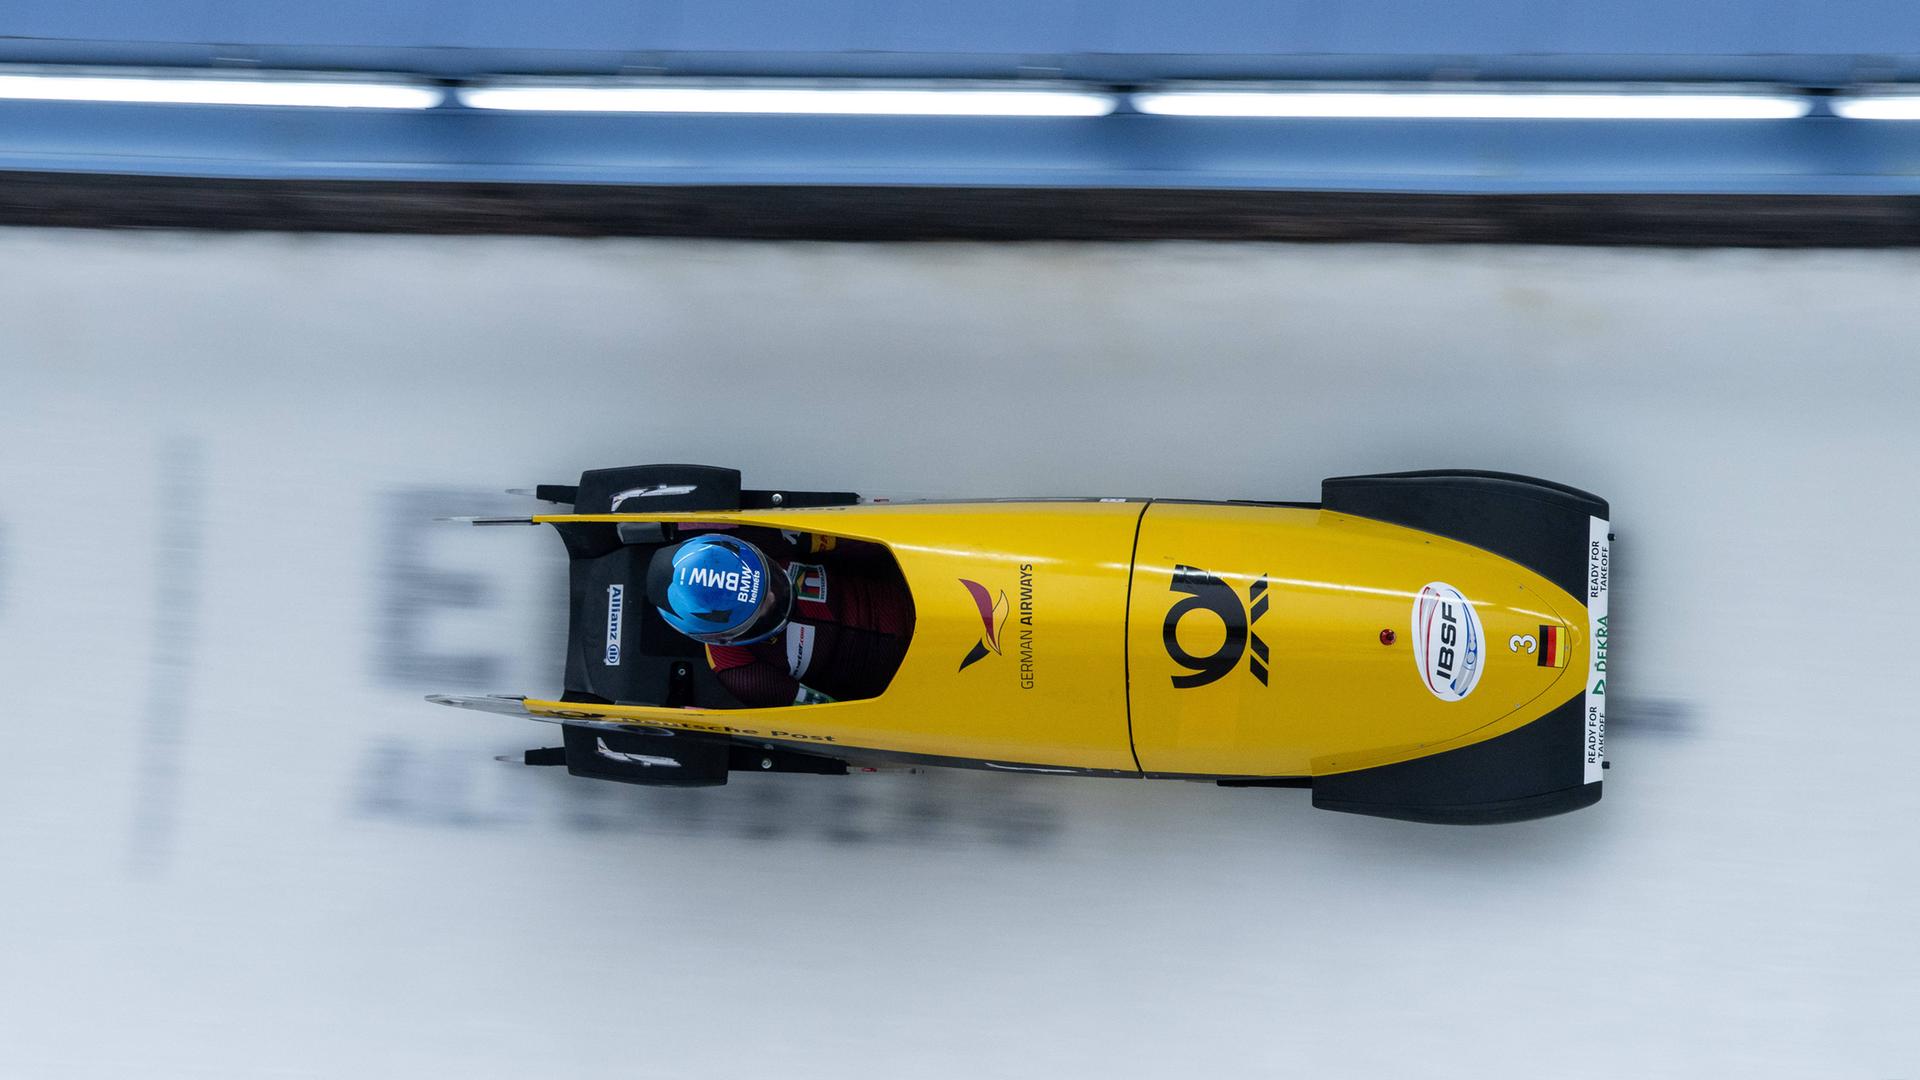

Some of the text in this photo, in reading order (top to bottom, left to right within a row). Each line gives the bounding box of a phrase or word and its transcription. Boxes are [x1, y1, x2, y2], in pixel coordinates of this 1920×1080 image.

[688, 567, 740, 592] BMW
[737, 566, 752, 603] BMW
[748, 570, 760, 604] helmets
[1590, 541, 1600, 598] READY FOR
[1600, 546, 1609, 592] TAKEOFF
[609, 586, 622, 640] Allianz
[1020, 564, 1035, 690] GERMAN AIRWAYS
[1436, 602, 1457, 680] IBSF
[1509, 634, 1537, 655] 3
[1596, 615, 1608, 672] DEKRA
[771, 730, 836, 742] Post
[1588, 706, 1597, 764] READY FOR
